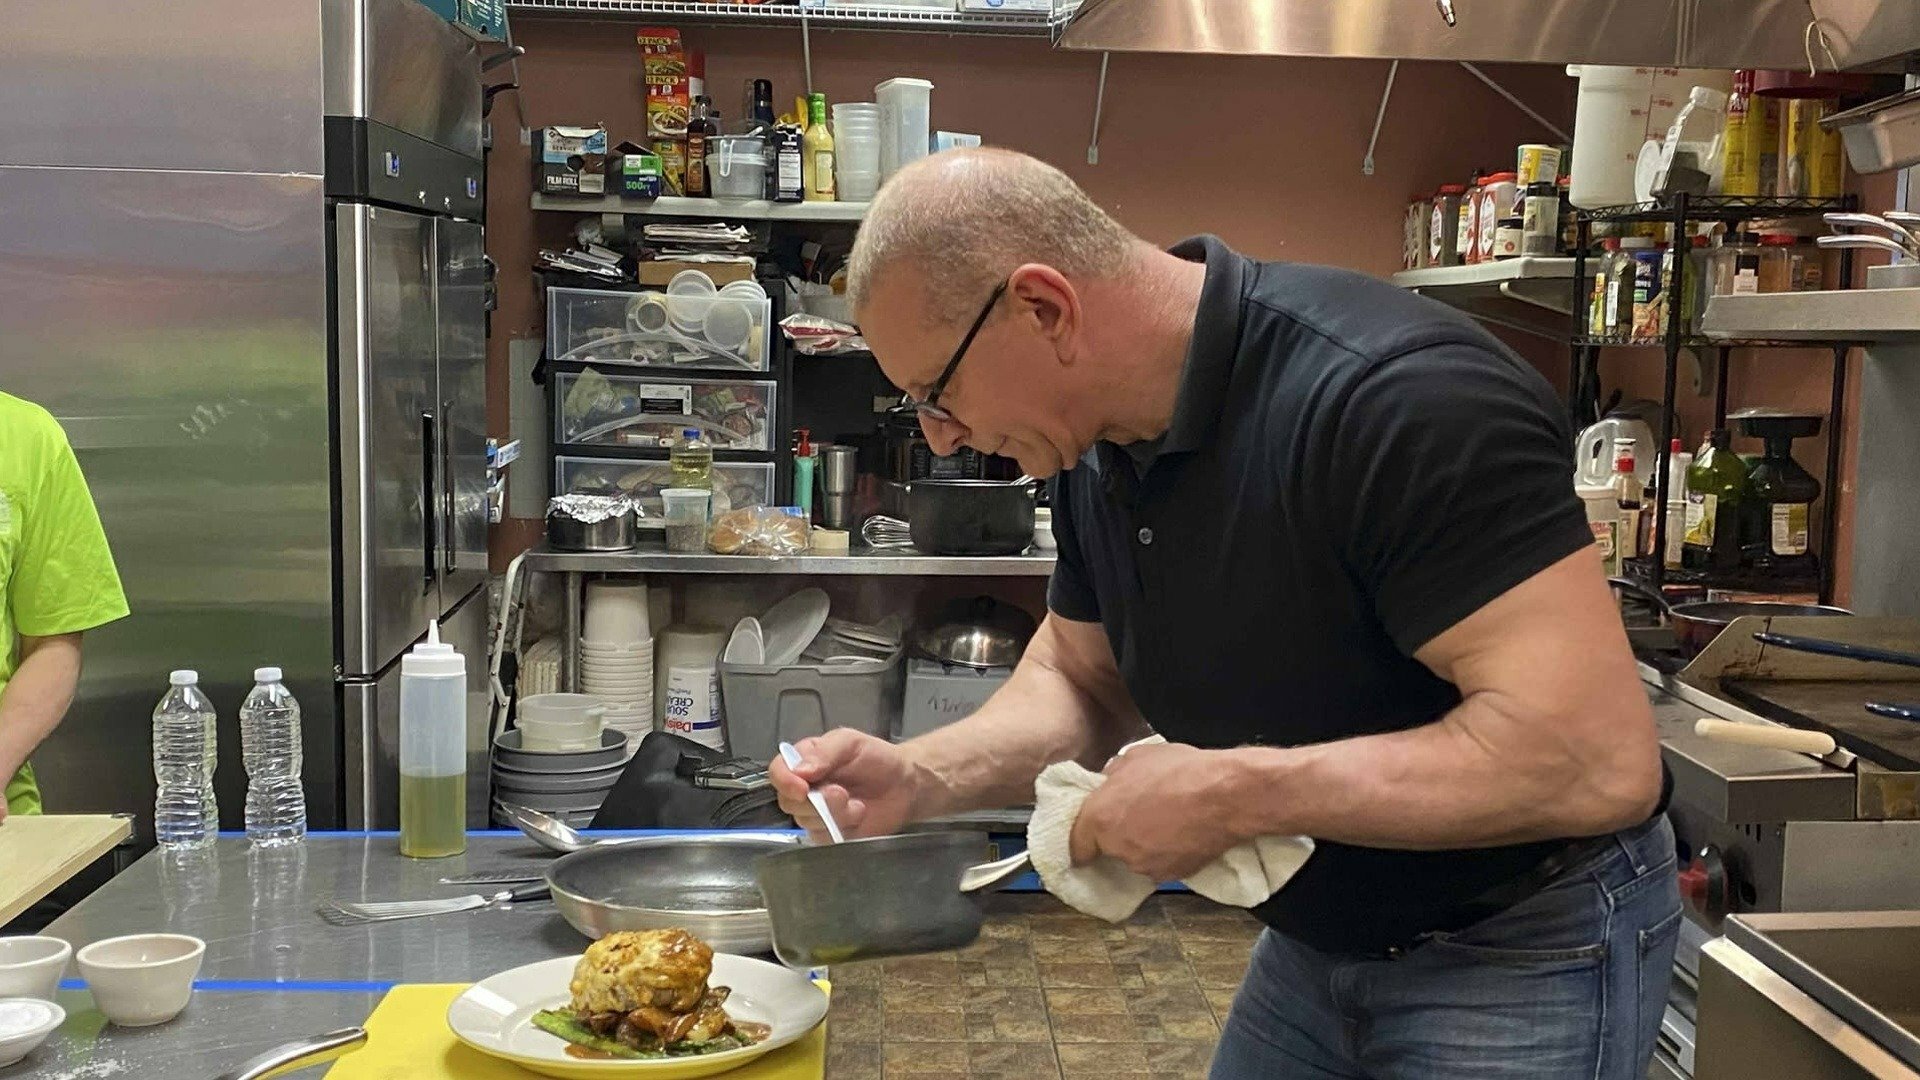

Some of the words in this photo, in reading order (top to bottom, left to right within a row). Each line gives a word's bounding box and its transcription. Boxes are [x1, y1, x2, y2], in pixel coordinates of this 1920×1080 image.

[655, 75, 676, 84] PACK
[546, 175, 562, 185] FILM
[562, 176, 579, 187] ROLL
[668, 696, 694, 707] CREA
